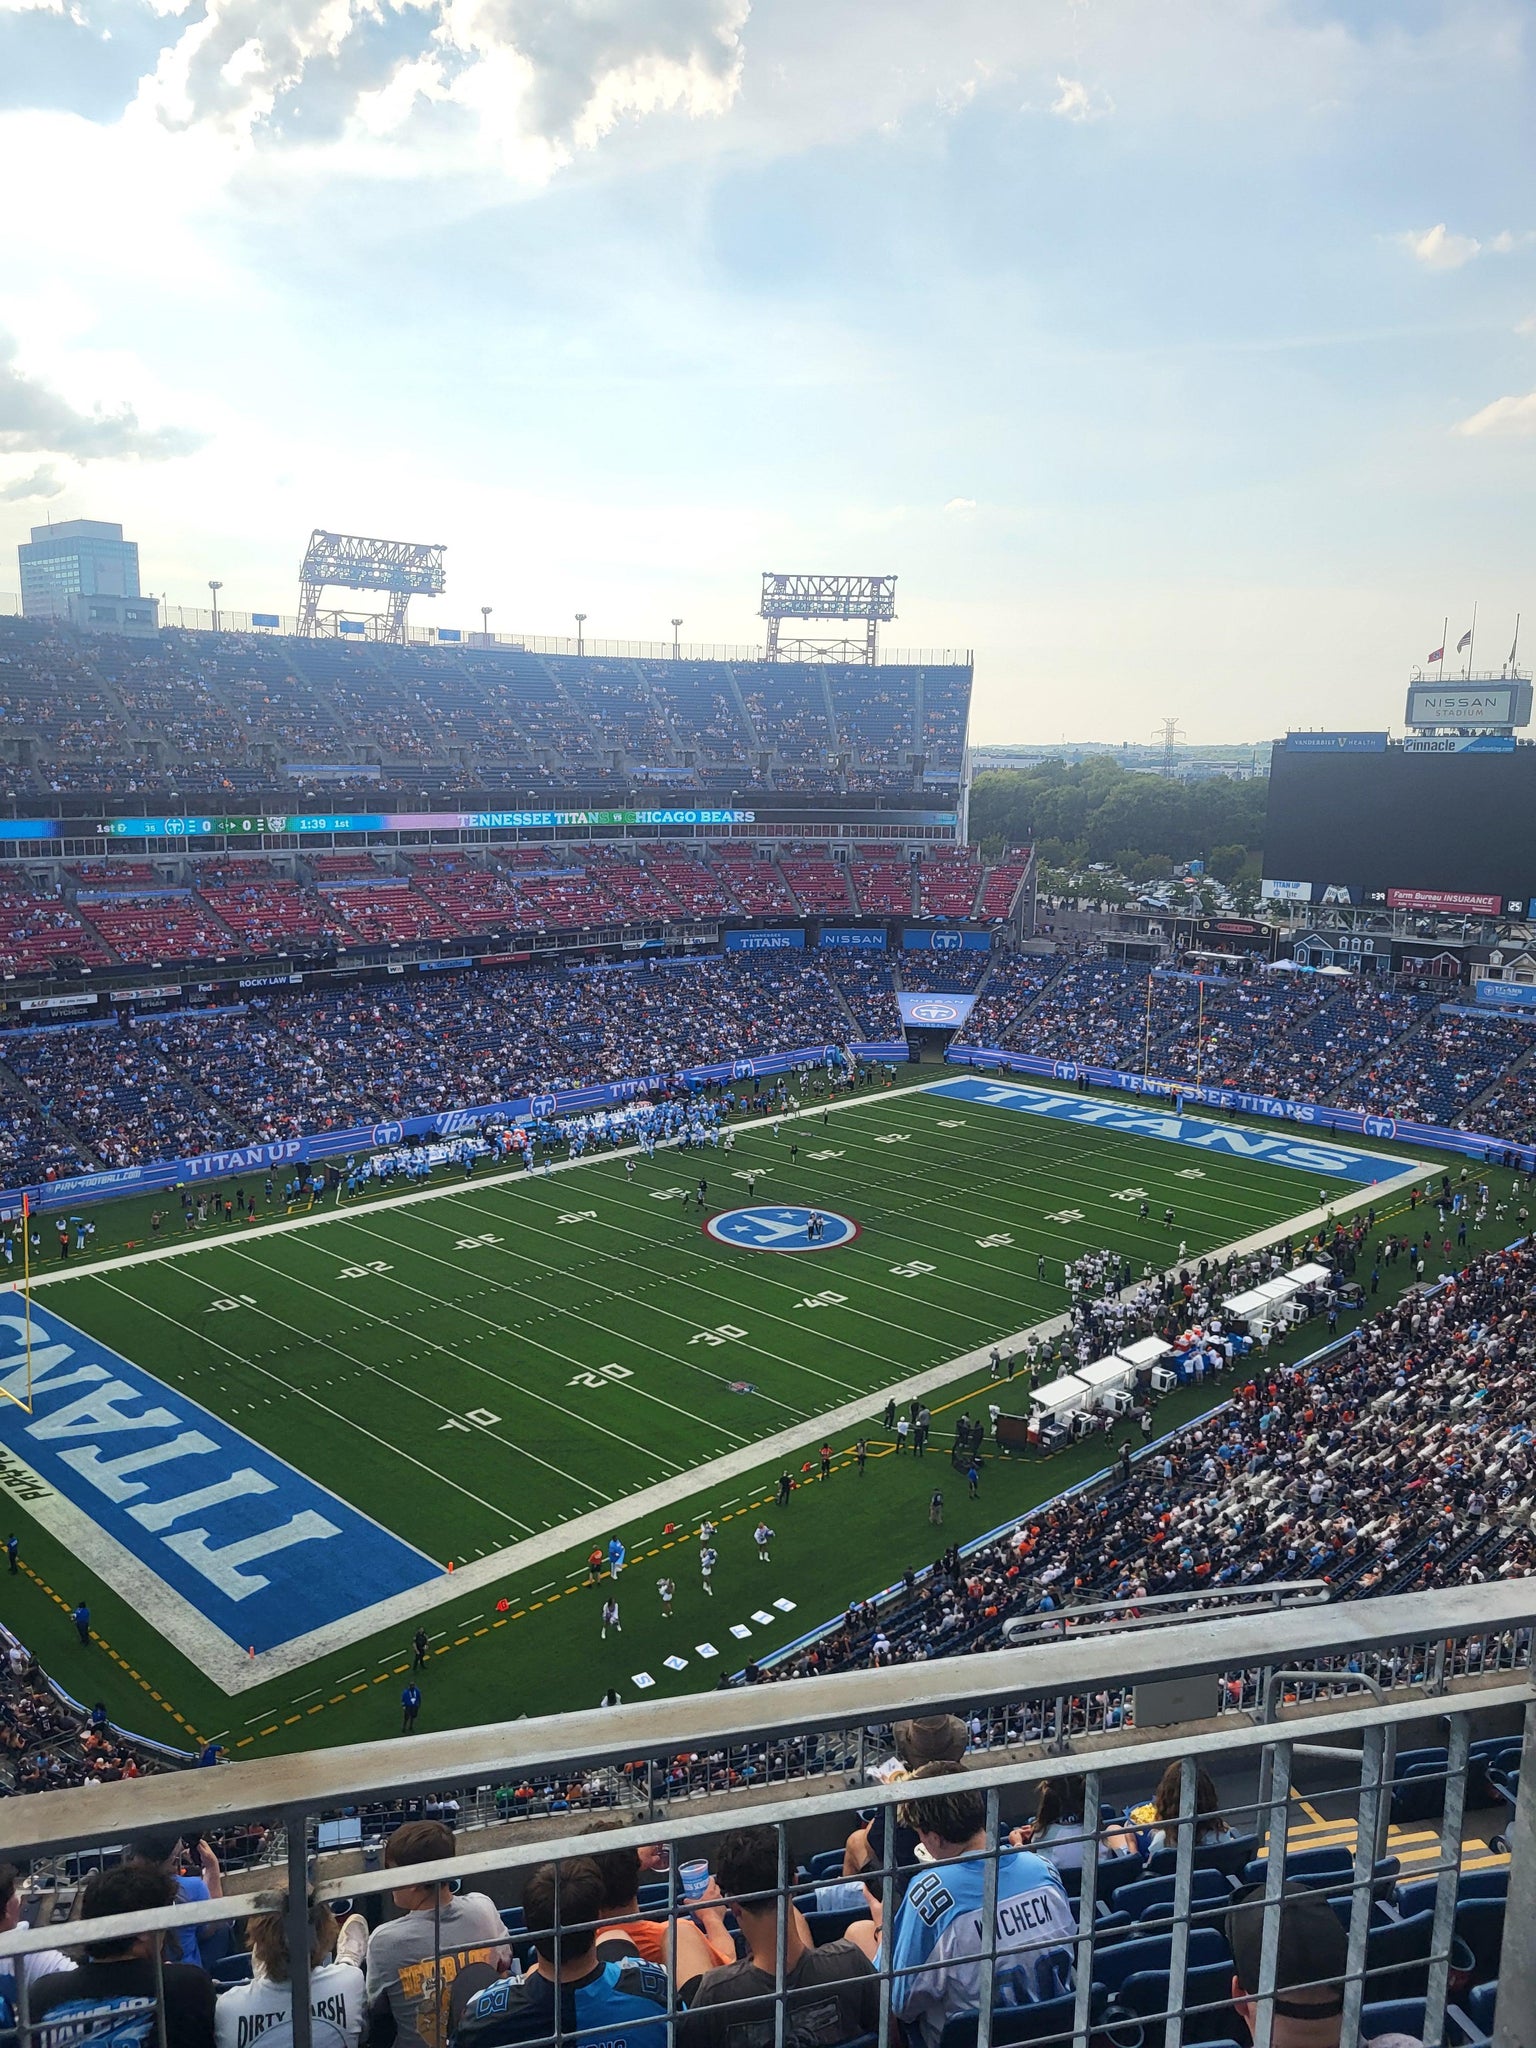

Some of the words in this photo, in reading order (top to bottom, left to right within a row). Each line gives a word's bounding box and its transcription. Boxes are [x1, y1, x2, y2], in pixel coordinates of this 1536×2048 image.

[1425, 697, 1497, 708] NISSAN
[1435, 708, 1484, 717] STADIUM
[1405, 739, 1456, 751] Pinnacle
[202, 820, 211, 831] 0
[242, 819, 251, 831] 0
[300, 819, 327, 829] 1:39
[334, 819, 350, 828] 1st
[457, 811, 551, 827] TENNESSEE
[554, 812, 609, 825] TITANS
[625, 811, 697, 824] CHICAGO
[700, 811, 756, 823] BEARS
[96, 824, 115, 833] 1st
[1273, 881, 1290, 889] TITAN
[1393, 890, 1413, 899] Farm
[1414, 892, 1442, 901] Bureau
[1443, 894, 1494, 905] INSURANCE
[1509, 901, 1520, 912] 25
[740, 937, 791, 948] TITANS
[825, 934, 883, 944] NISSAN
[198, 983, 222, 993] FedEx
[239, 978, 268, 989] ROCKY
[269, 976, 287, 985] LAW
[609, 1077, 660, 1098] TITAN
[1236, 1093, 1316, 1122] TITANS
[974, 1086, 1363, 1171] TITANS
[185, 1149, 263, 1176] TITAN
[266, 1142, 301, 1160] UP
[1109, 1187, 1150, 1202] 20
[558, 1209, 598, 1225] 40
[1043, 1208, 1086, 1225] 30
[455, 1233, 505, 1249] 30
[975, 1233, 1016, 1250] 40
[339, 1260, 395, 1279] 20
[888, 1260, 937, 1278] 50
[211, 1294, 258, 1312] 10
[801, 1290, 849, 1308] 40
[692, 1324, 749, 1347] 30
[572, 1362, 635, 1388] 20
[446, 1407, 503, 1433] 10
[636, 1675, 651, 1685] S
[908, 1871, 956, 1928] 89
[237, 2010, 287, 2048] DIRTY
